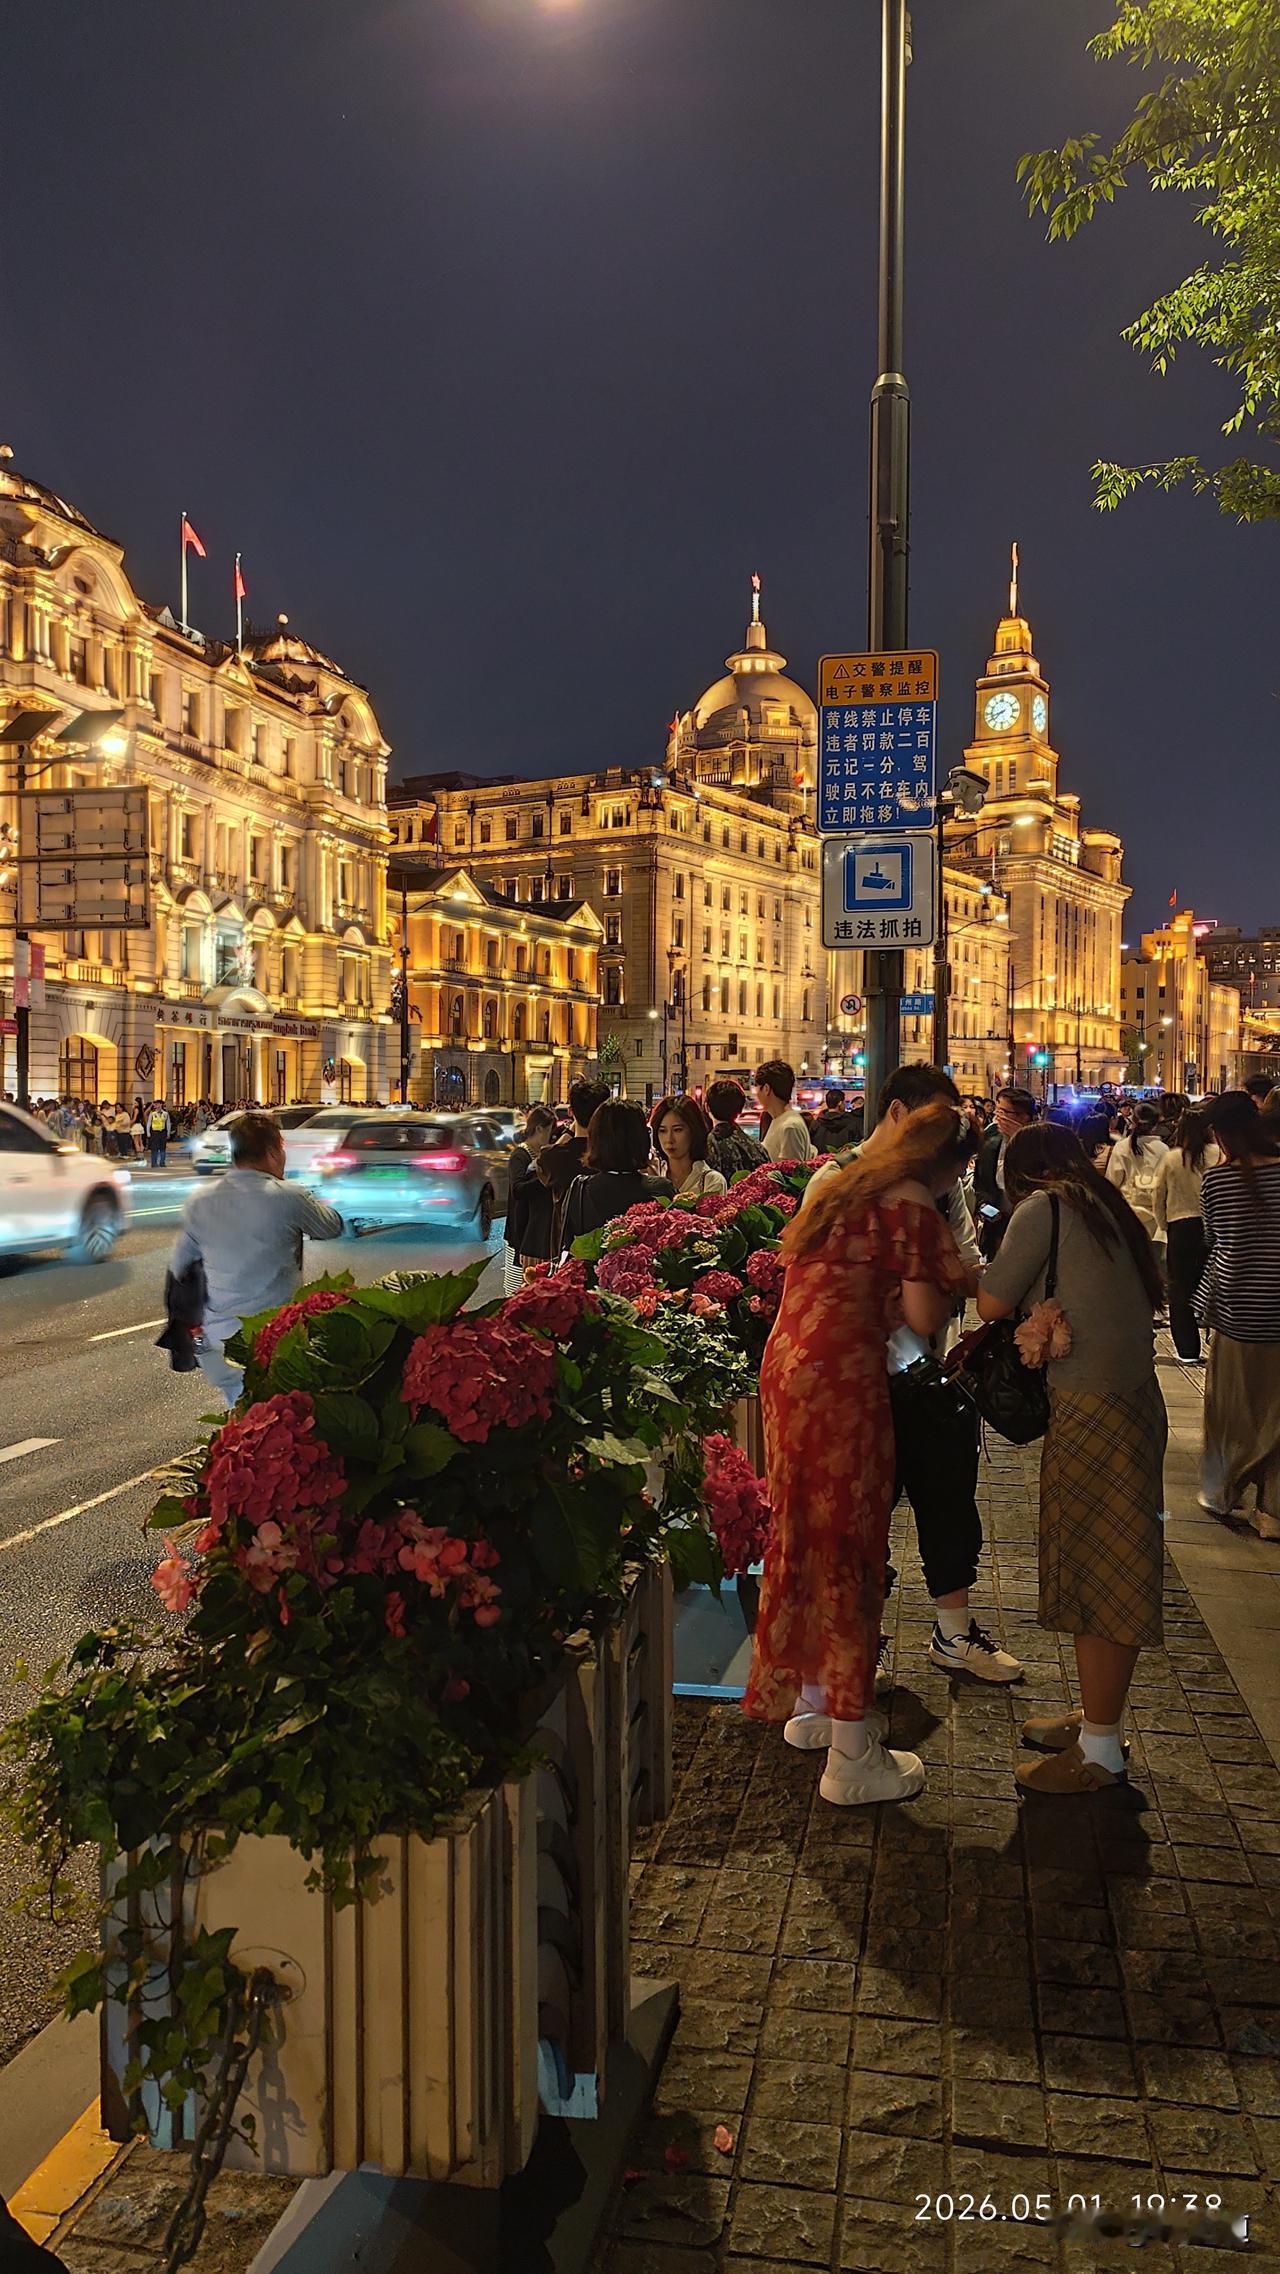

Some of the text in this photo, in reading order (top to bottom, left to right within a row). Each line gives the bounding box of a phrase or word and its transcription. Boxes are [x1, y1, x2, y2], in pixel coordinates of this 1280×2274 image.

[853, 660, 923, 677] 交警提醒
[826, 681, 930, 699] 电子警察监控
[826, 707, 931, 729] 黄线禁止停车
[826, 731, 930, 753] 违者罚款二百
[825, 780, 929, 801] 驶员不在车内
[833, 918, 922, 940] 违法抓拍
[900, 998, 922, 1006] 州路
